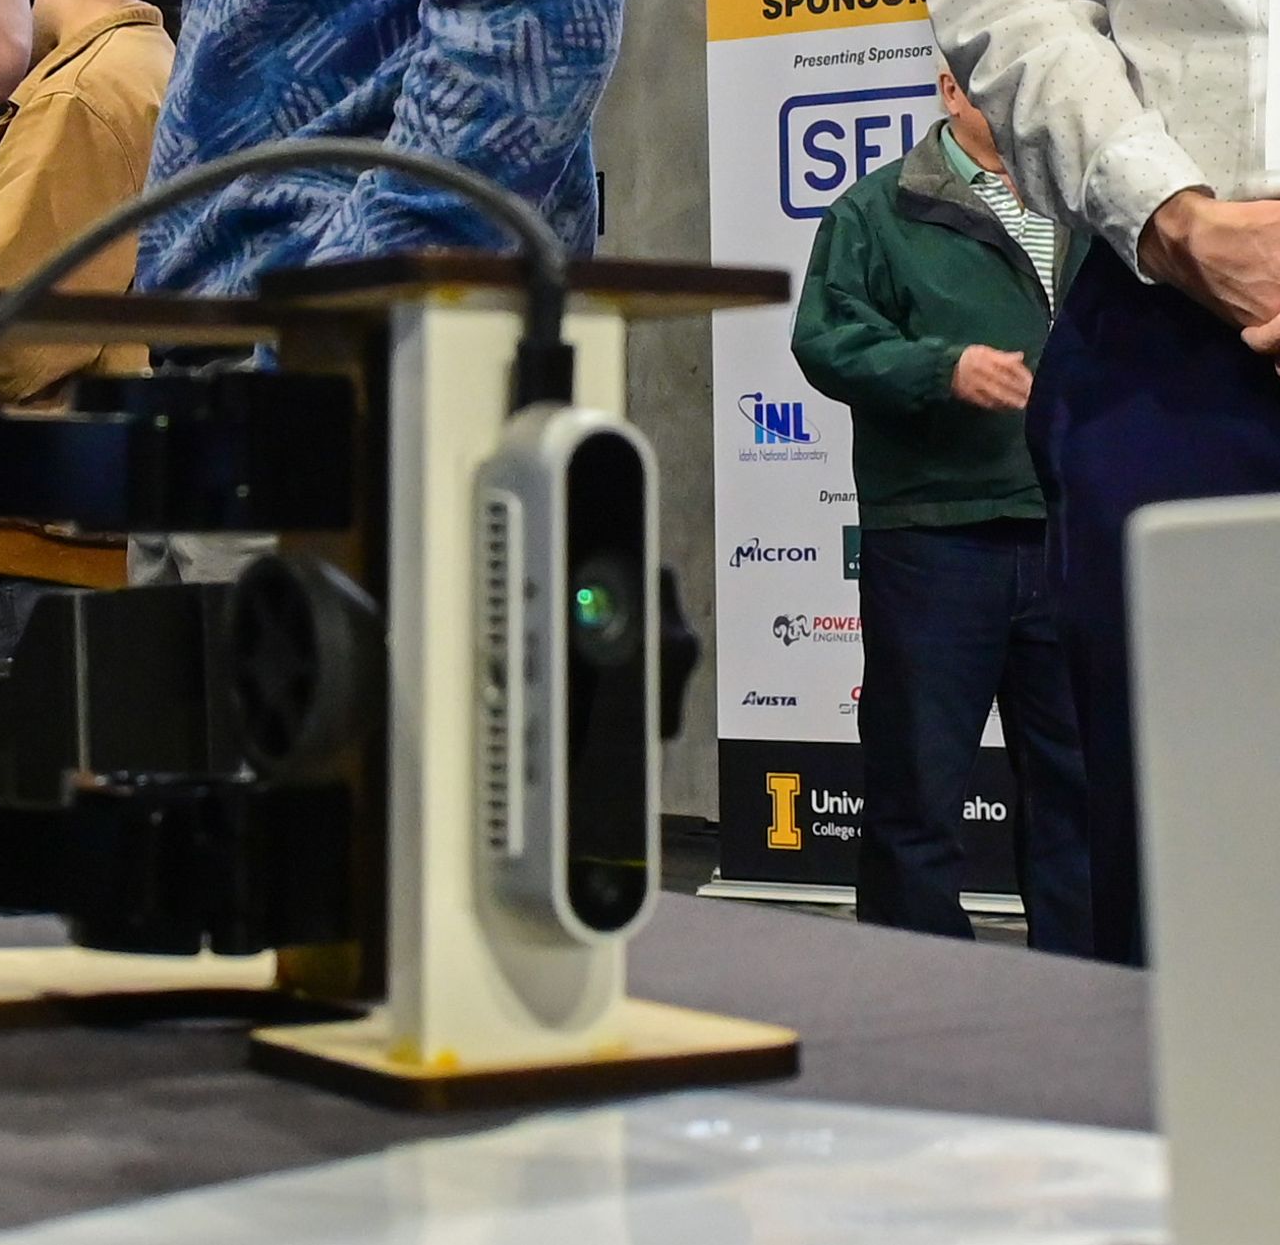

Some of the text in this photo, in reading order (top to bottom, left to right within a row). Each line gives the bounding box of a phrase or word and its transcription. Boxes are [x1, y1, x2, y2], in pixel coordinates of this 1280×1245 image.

[793, 42, 934, 69] Presenting Sponsors
[738, 446, 828, 464] Idaho National Laboratory
[812, 821, 855, 842] College
